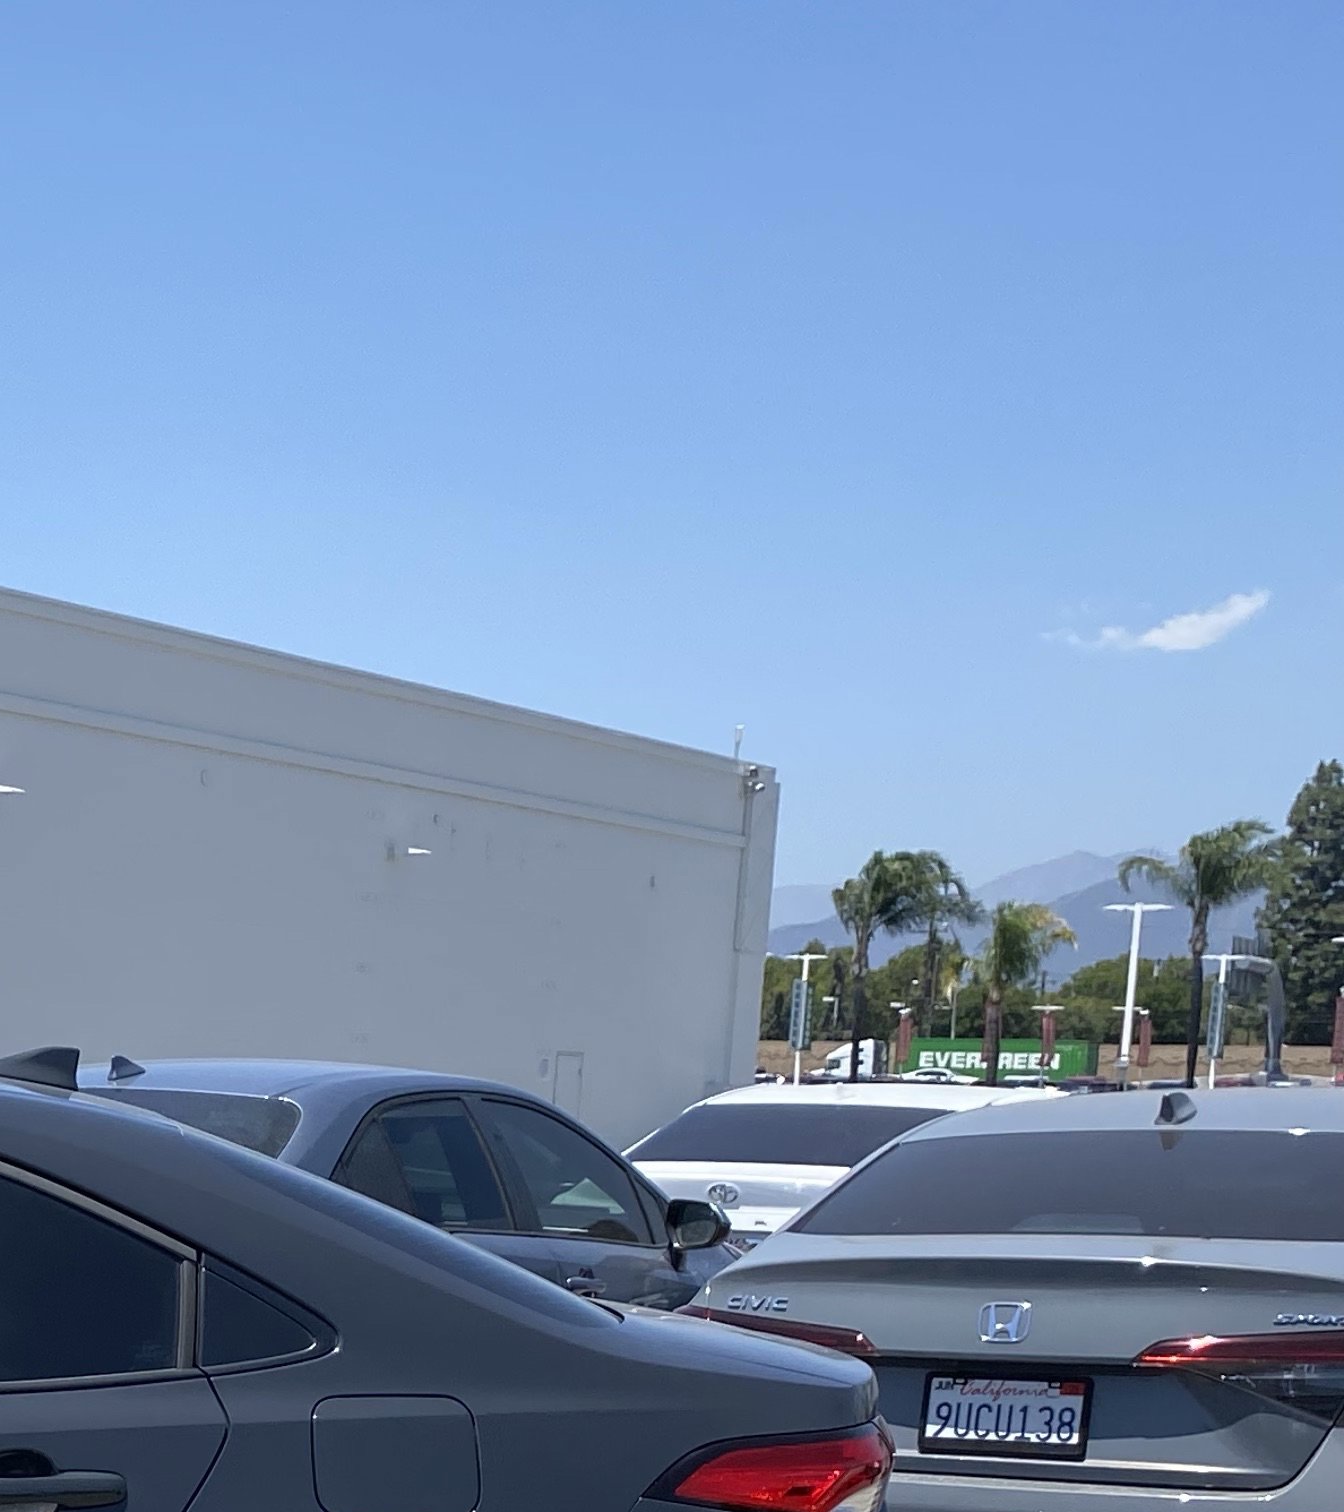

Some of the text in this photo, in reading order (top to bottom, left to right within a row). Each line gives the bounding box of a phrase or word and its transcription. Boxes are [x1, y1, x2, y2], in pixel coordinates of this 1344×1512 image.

[918, 1050, 1061, 1070] EVERREEN
[728, 1295, 789, 1313] CIVIC
[960, 1379, 1050, 1402] California
[932, 1402, 1076, 1443] 9UCU138
